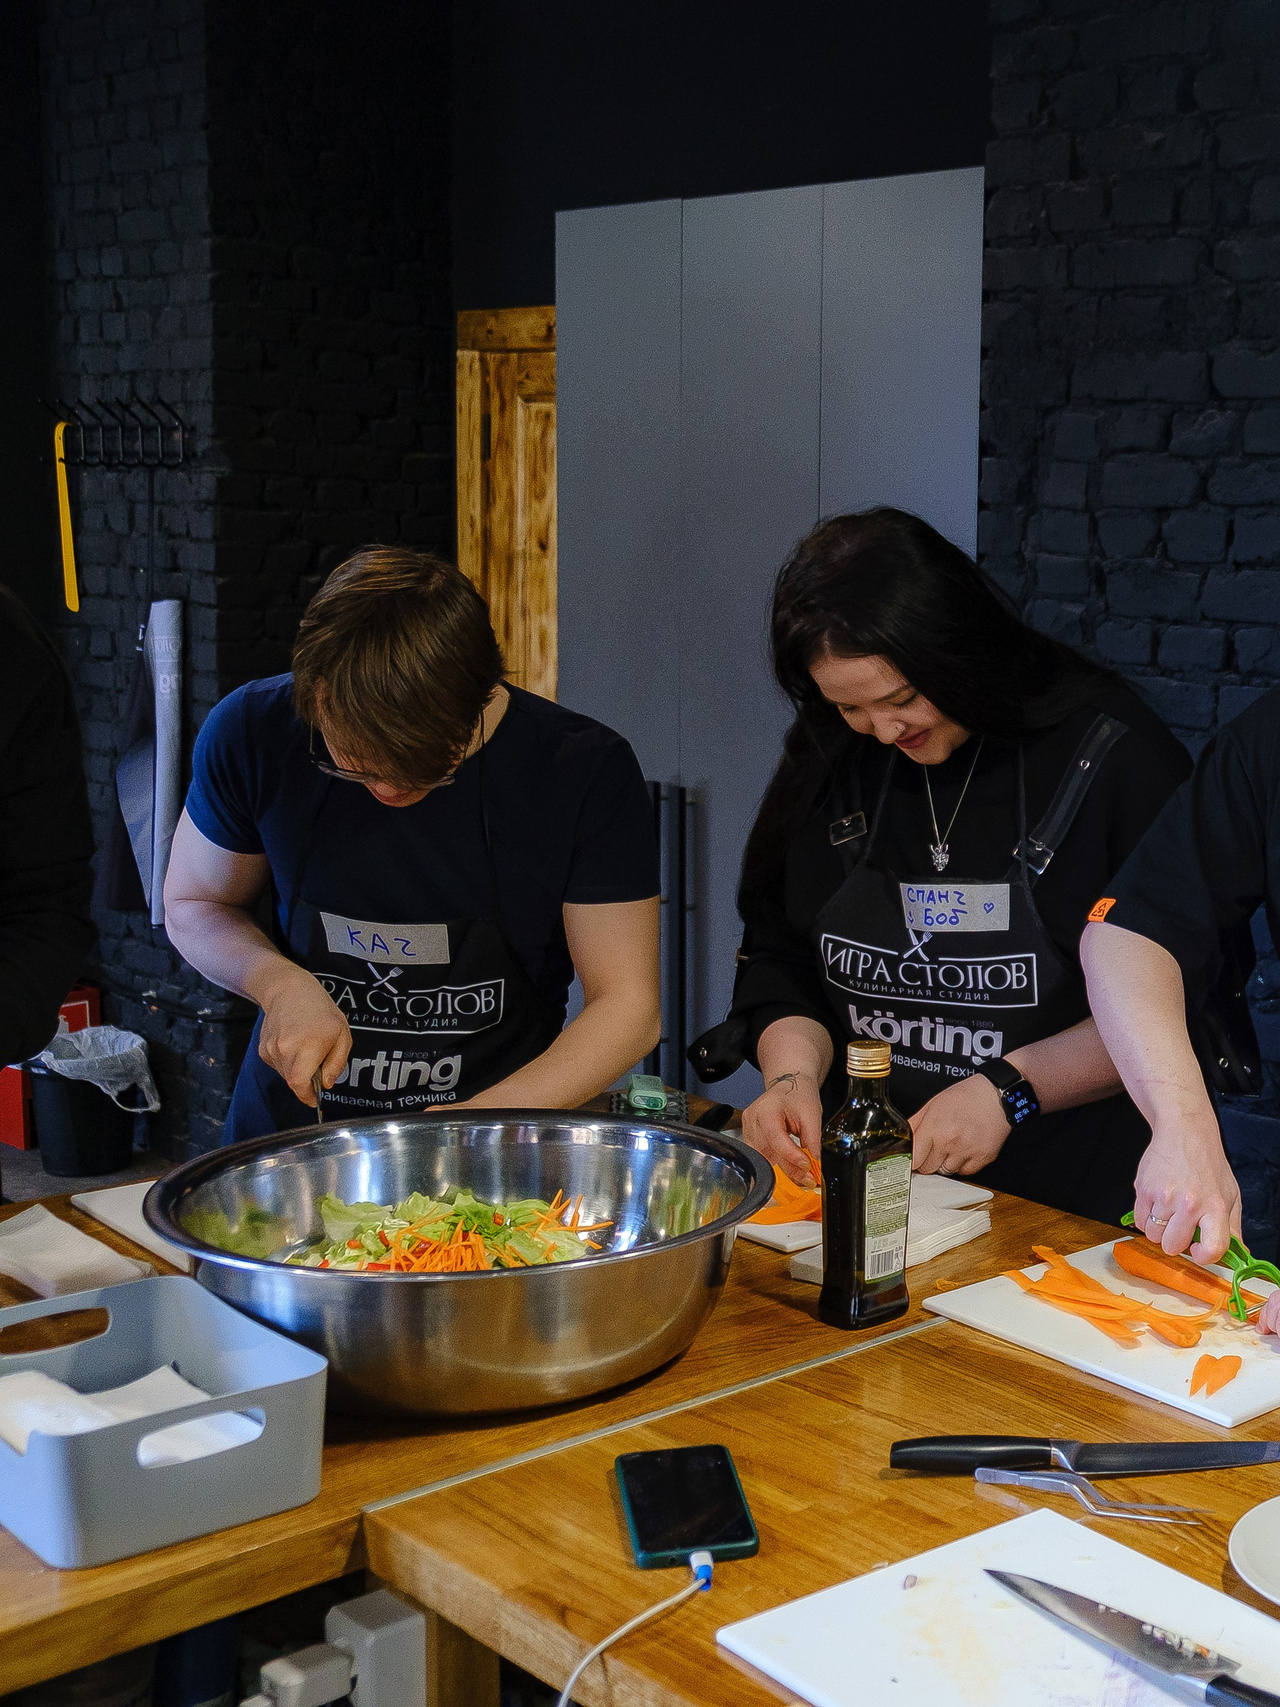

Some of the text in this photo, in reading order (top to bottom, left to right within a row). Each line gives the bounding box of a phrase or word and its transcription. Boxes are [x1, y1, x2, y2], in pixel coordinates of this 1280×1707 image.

[827, 943, 1028, 990] ИГРА СТОЛОВ
[320, 980, 495, 1017] РА СТОЛОВ
[849, 979, 991, 1001] КУЛИНАРНАЯ СТУДИЯ
[406, 1018, 458, 1028] ТУДИЯ
[848, 1004, 1003, 1066] körting
[334, 1051, 462, 1091] rting
[890, 1053, 976, 1077] иваемая техн
[398, 1090, 456, 1108] техника
